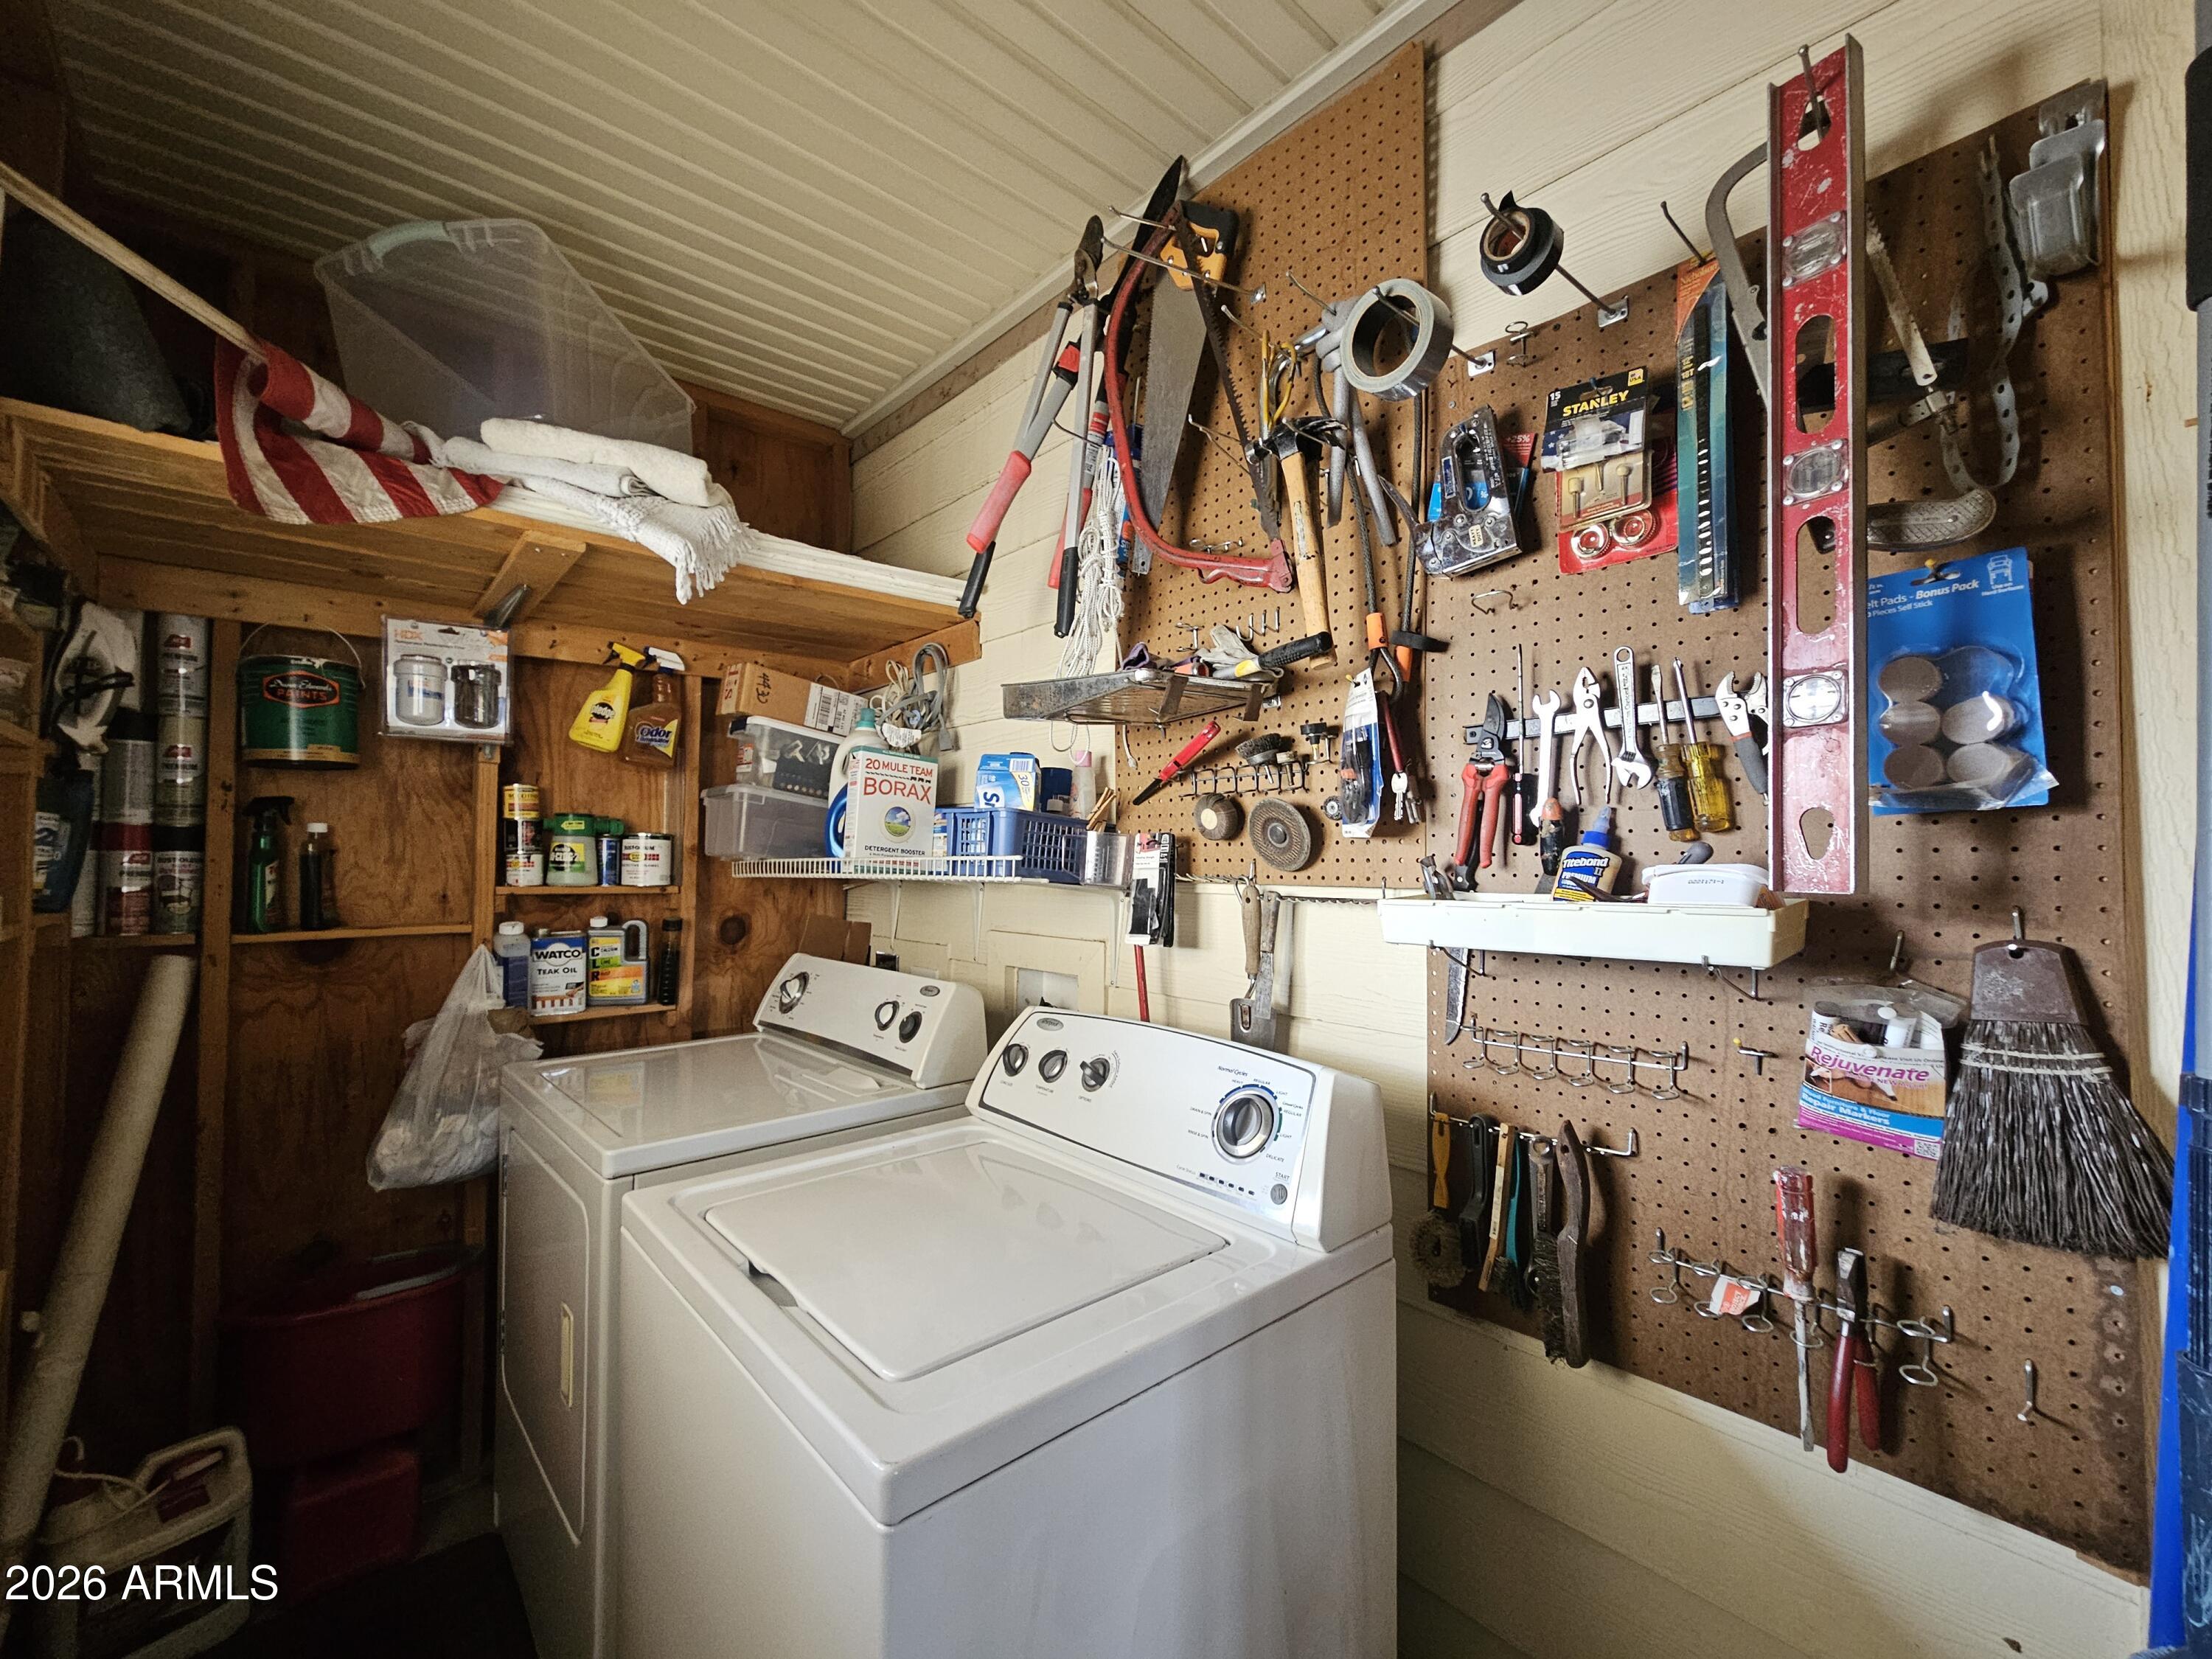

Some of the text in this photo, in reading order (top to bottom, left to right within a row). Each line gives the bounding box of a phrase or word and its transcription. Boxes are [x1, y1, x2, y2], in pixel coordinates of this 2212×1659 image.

[1550, 392, 1561, 400] 15
[1563, 390, 1629, 417] STANLEY
[1867, 599, 1879, 609] elt
[1880, 594, 1907, 606] Pads
[1915, 585, 1950, 599] Bonus
[1951, 579, 1980, 593] Pack
[1913, 599, 1933, 609] Stick
[639, 726, 672, 739] Odor
[866, 758, 933, 777] 20 MULE TEAM
[1018, 774, 1029, 787] 30
[863, 776, 932, 805] BORAX
[864, 845, 900, 854] DETERGENT
[1563, 857, 1609, 869] Titebond
[1593, 866, 1604, 877] II
[535, 949, 581, 960] WATCO
[591, 947, 600, 957] C
[592, 959, 600, 970] L
[537, 967, 578, 976] TEAK OIL
[591, 970, 600, 981] R
[1811, 1046, 1930, 1082] Rejuvenate
[1218, 1065, 1248, 1077] Normal Cycles
[1283, 1109, 1302, 1118] REGULAR
[1801, 1092, 1891, 1125] Repair Markers
[1265, 1153, 1285, 1163] DELICATE
[1275, 1172, 1290, 1180] START
